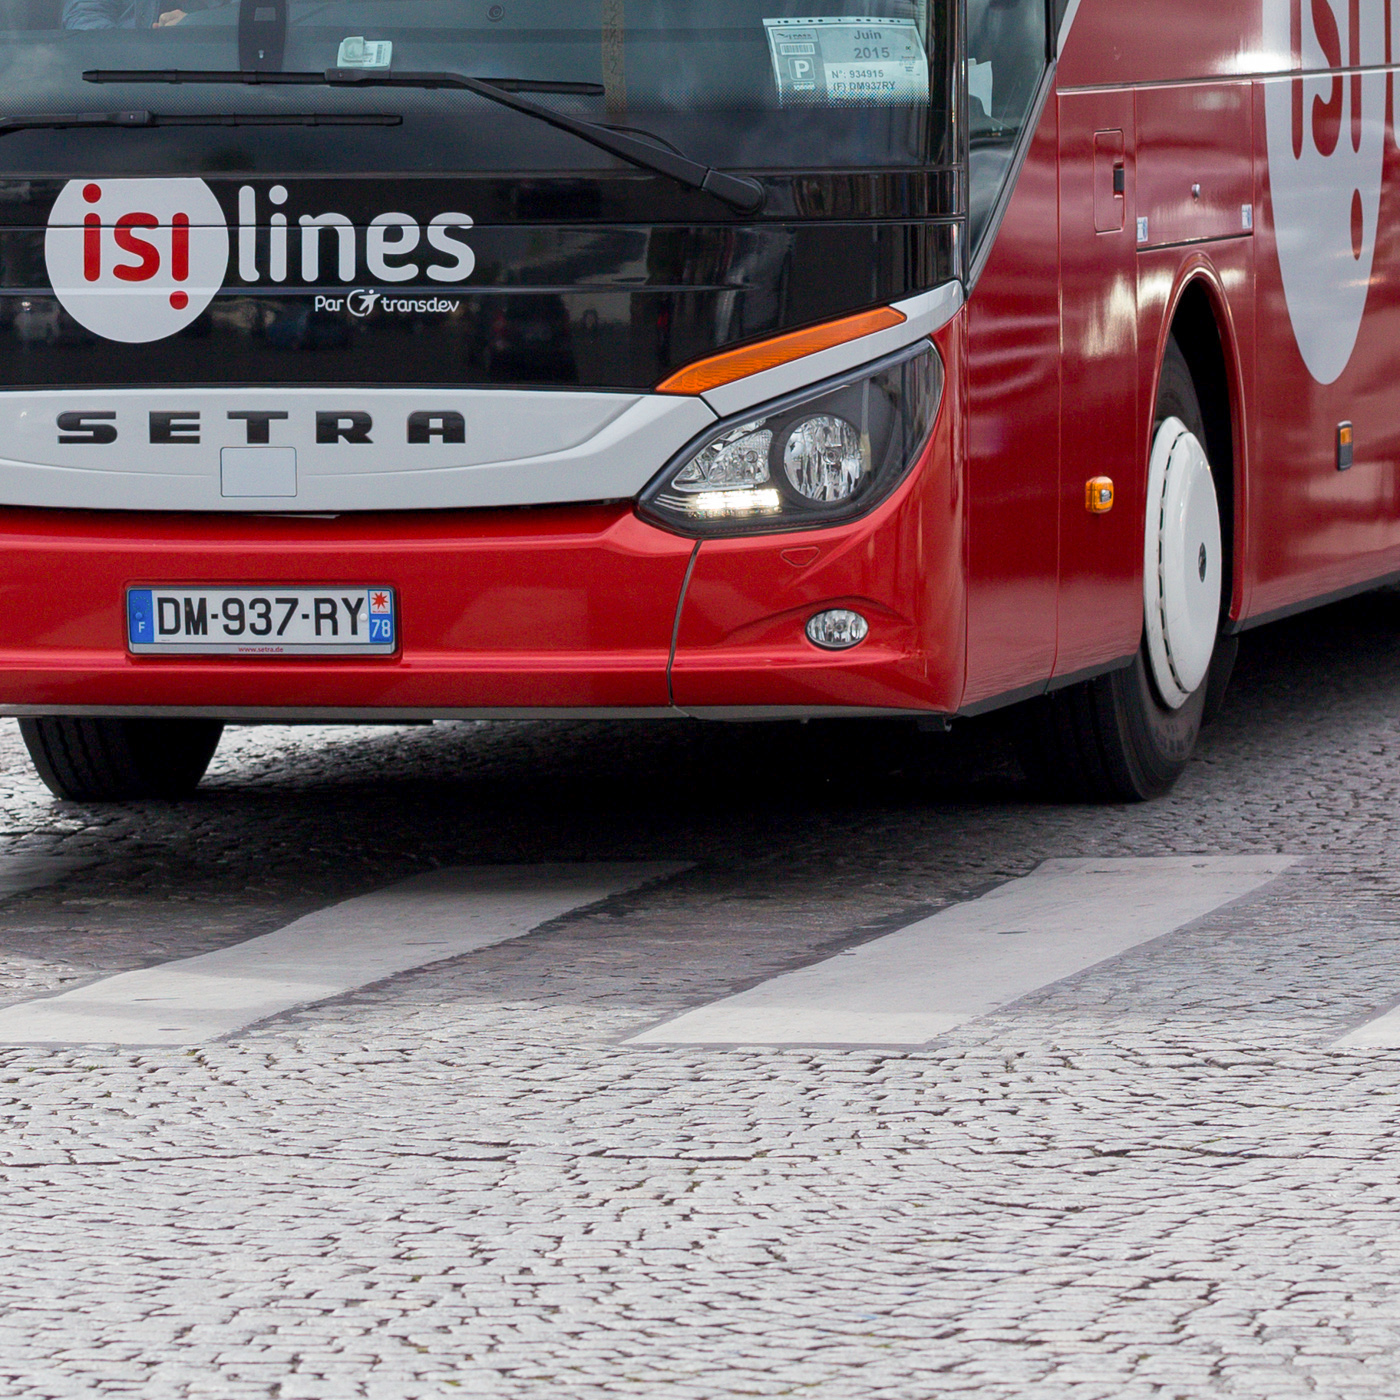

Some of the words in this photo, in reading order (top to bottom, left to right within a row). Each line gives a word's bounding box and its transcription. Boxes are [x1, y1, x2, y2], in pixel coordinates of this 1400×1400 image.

[853, 29, 882, 40] Juin
[853, 46, 890, 59] 2015
[849, 69, 884, 79] 934915
[314, 295, 345, 312] Par
[380, 296, 460, 313] transdev
[56, 409, 466, 445] SETRA
[138, 621, 146, 634] F
[371, 619, 391, 638] 78
